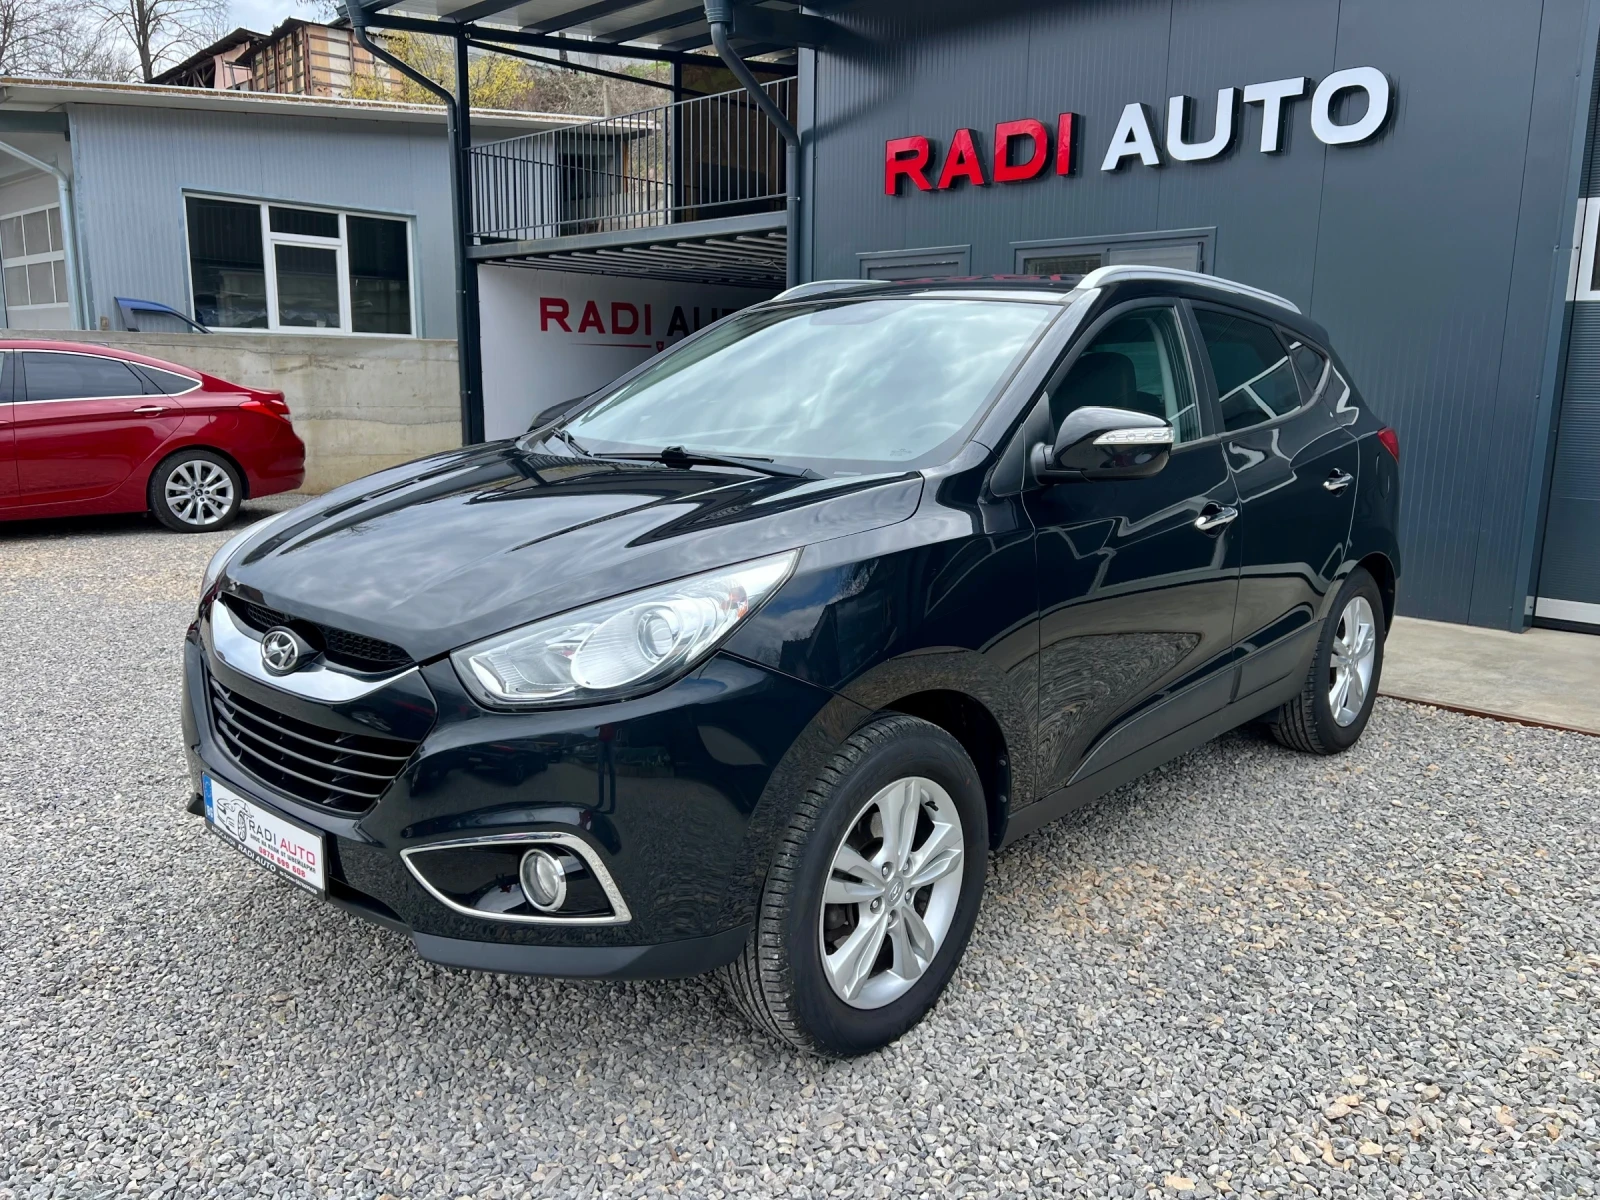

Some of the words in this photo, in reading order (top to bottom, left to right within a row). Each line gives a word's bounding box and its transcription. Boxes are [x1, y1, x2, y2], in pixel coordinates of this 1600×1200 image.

[886, 112, 1077, 195] RADI
[1101, 65, 1392, 172] AUTO
[540, 297, 652, 336] RADI
[667, 305, 738, 336] AU
[238, 844, 254, 859] RADI
[255, 856, 276, 872] AUTO
[248, 820, 277, 845] RADI
[280, 838, 316, 866] AUTO
[258, 846, 275, 861] 0878
